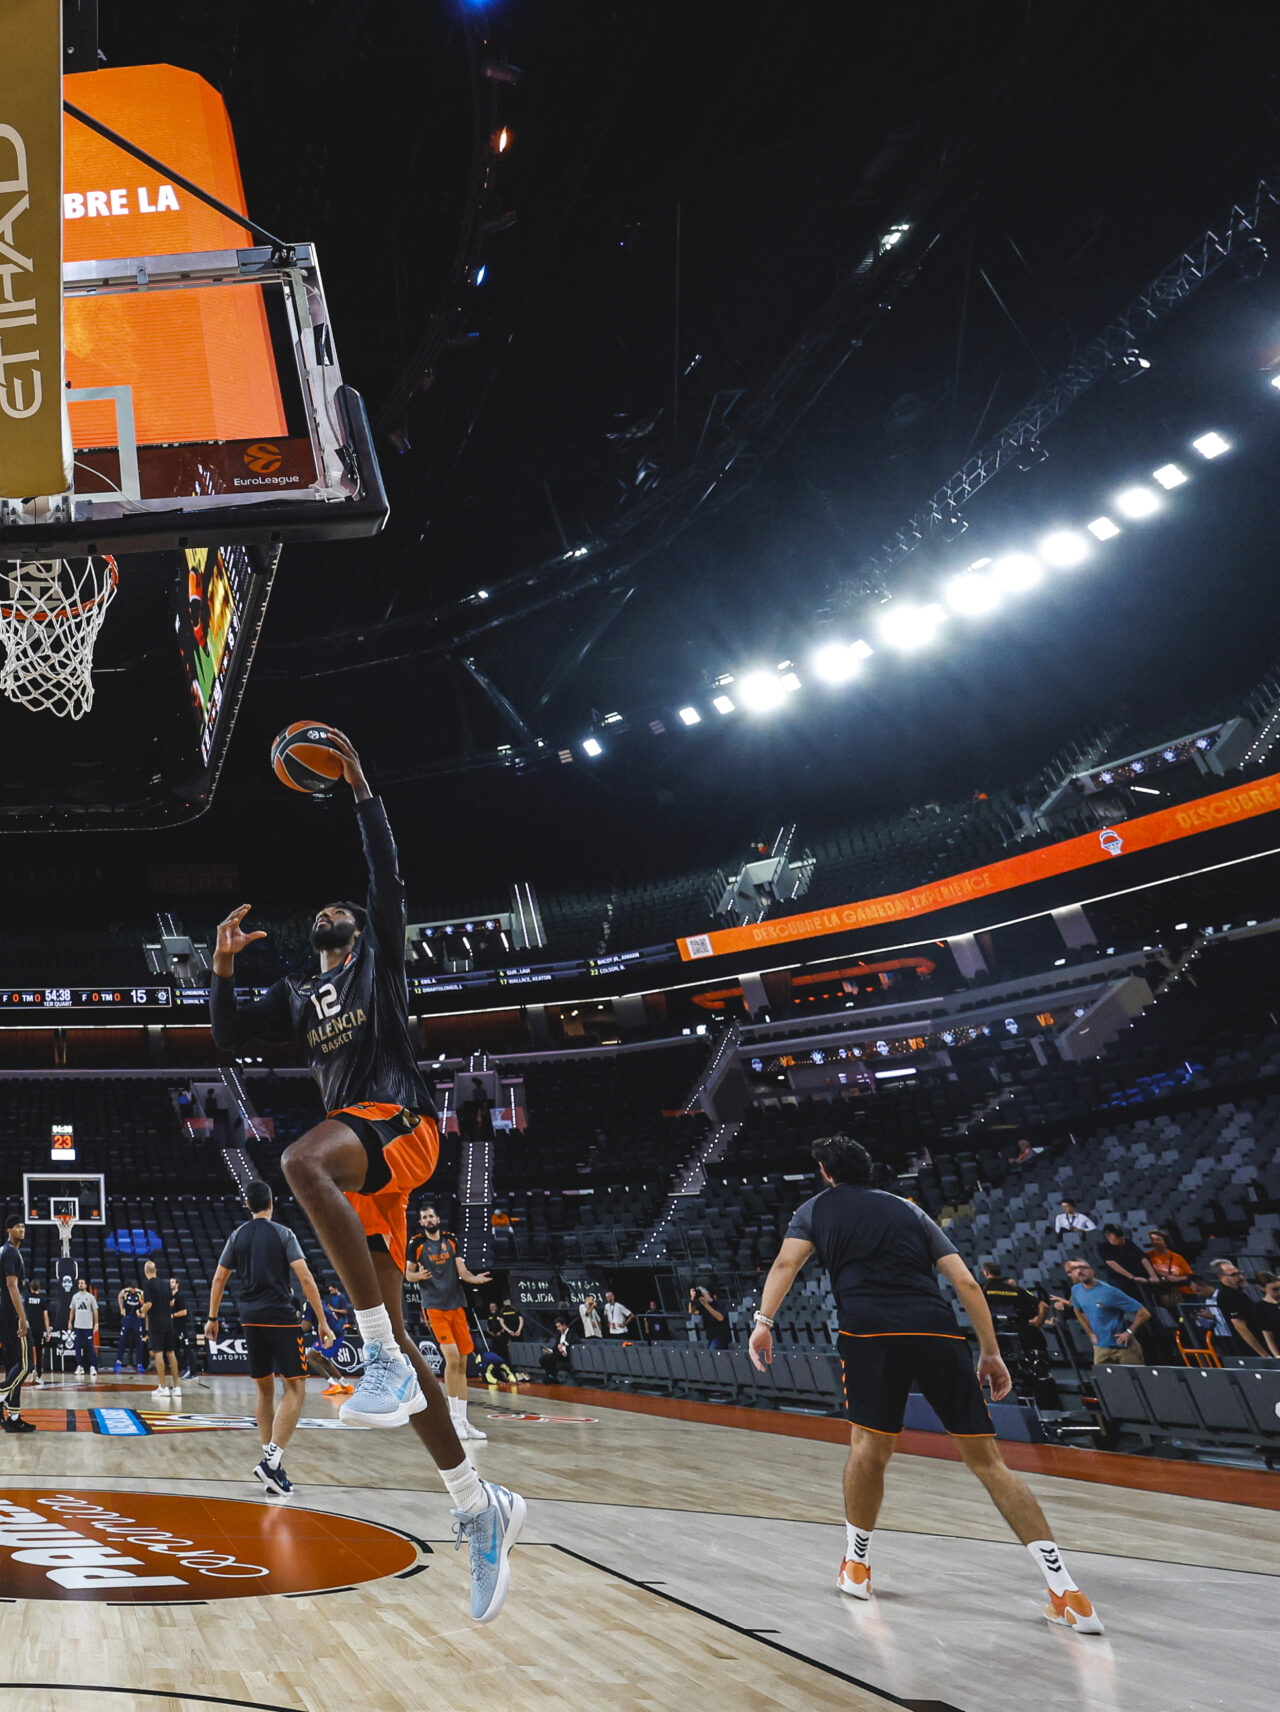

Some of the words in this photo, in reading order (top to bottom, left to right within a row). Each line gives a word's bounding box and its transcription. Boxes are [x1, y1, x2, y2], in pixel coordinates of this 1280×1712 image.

[137, 185, 180, 213] LA
[234, 475, 300, 486] EuroLeague
[1176, 785, 1277, 829] DESCUBRE
[752, 917, 823, 943] DESCUBRE
[824, 914, 841, 926] LA
[843, 899, 910, 925] GAMEDAY
[912, 873, 995, 909] EXPERIENCE
[12, 993, 19, 1002] 0
[34, 993, 41, 1002] 0
[45, 989, 71, 1001] 54:38
[92, 993, 99, 1001] 0
[114, 993, 121, 1001] 0
[130, 990, 147, 1004] 15
[310, 983, 341, 1020] 12
[1036, 1013, 1054, 1027] VS
[306, 1009, 367, 1048] VALENCIA
[321, 1031, 353, 1053] BASKET
[908, 1036, 925, 1051] VS
[780, 1055, 796, 1068] VS
[53, 1135, 72, 1149] 23
[28, 1297, 40, 1305] STAFF
[337, 1350, 350, 1363] SH
[36, 1494, 270, 1578] Cerámica
